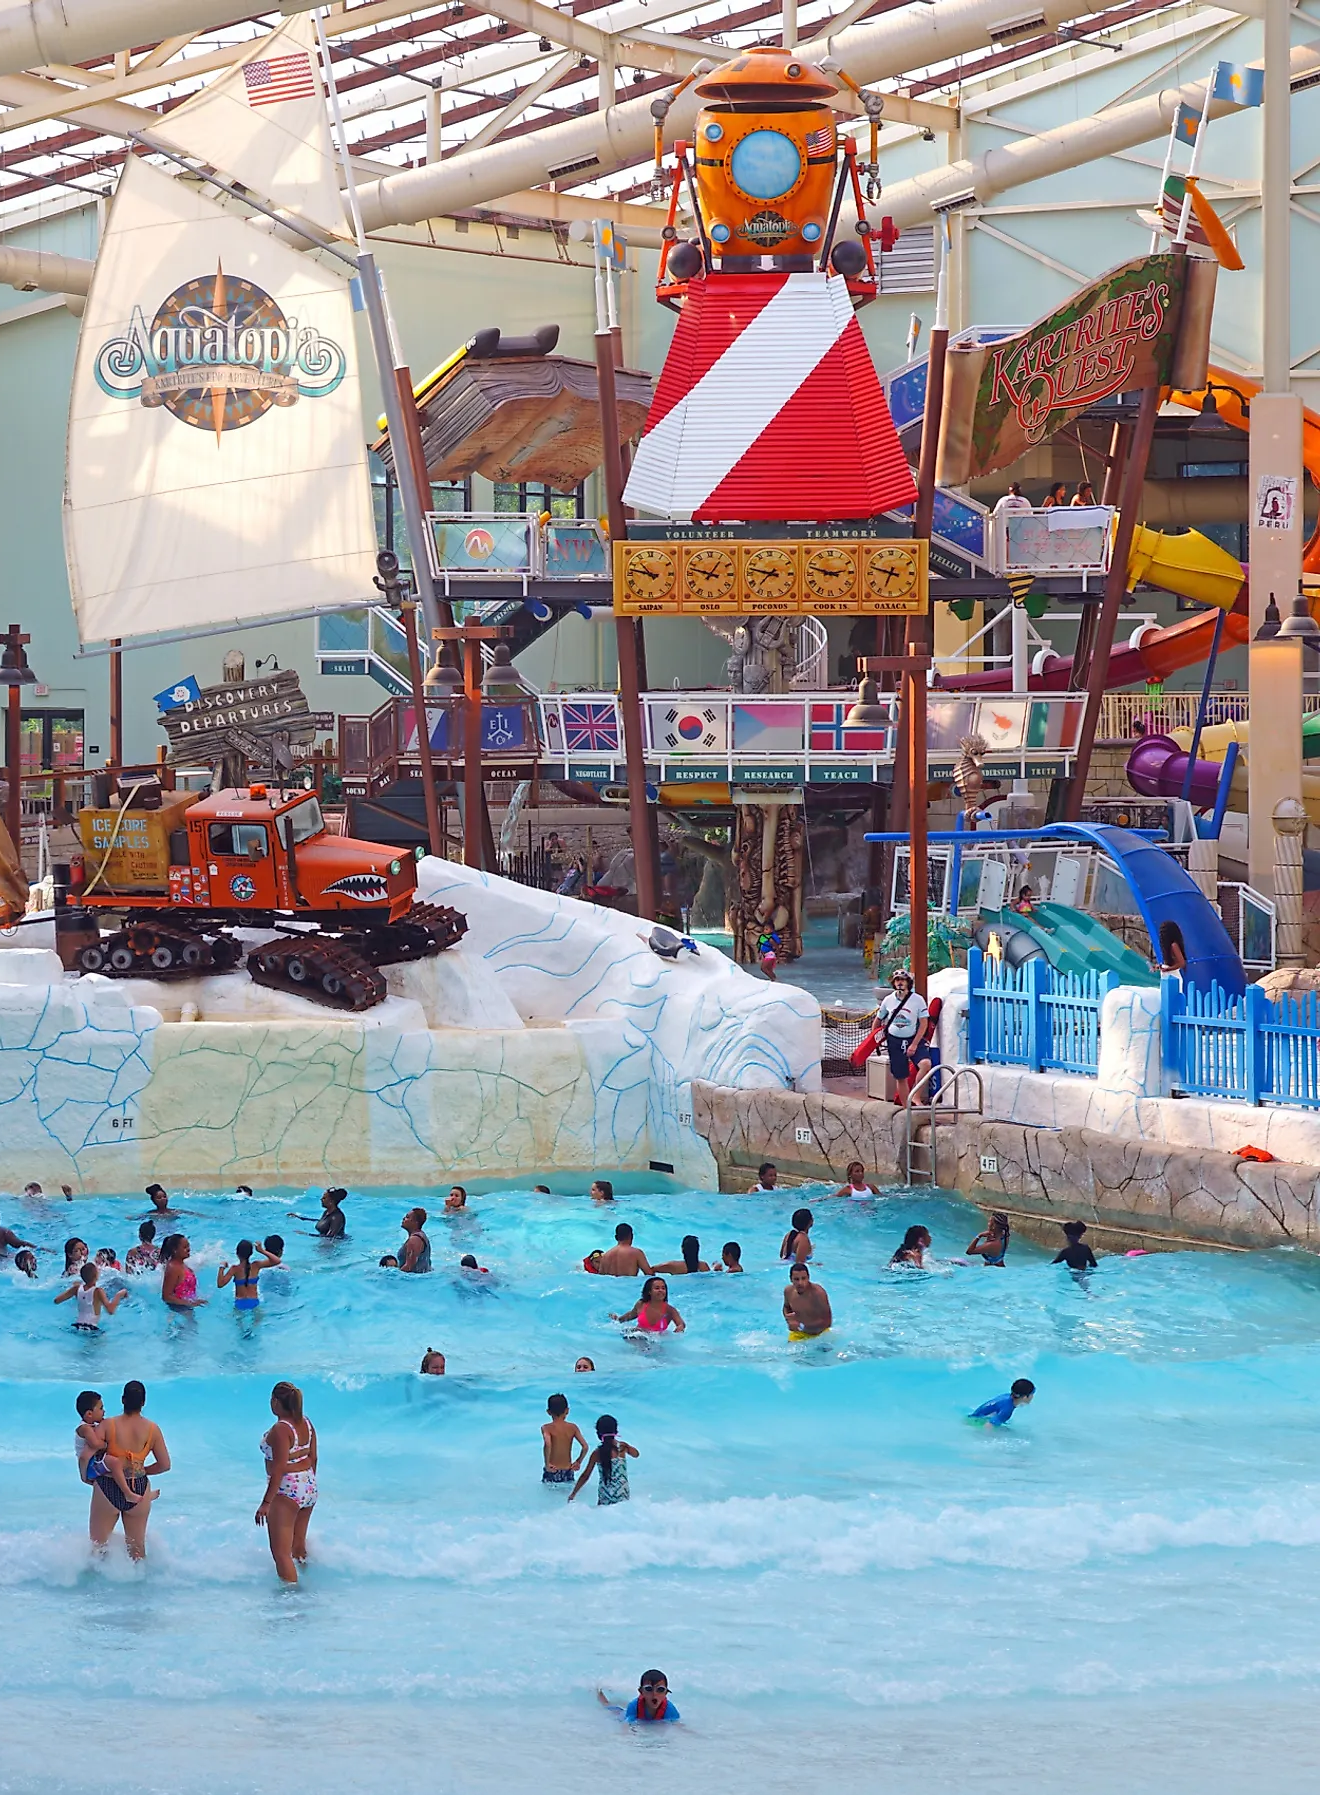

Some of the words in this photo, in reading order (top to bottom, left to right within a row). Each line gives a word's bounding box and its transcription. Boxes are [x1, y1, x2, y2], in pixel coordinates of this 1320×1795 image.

[737, 217, 797, 237] Aquatopia
[988, 279, 1170, 406] KARTRITE'S
[100, 305, 340, 392] Aquatopia
[1015, 334, 1136, 445] QUEST
[1258, 519, 1289, 528] PERU
[665, 531, 735, 539] VOLUNTEER
[806, 529, 878, 538] TEAMWORK
[552, 538, 594, 562] NW
[929, 552, 965, 576] ATELLITE
[184, 683, 280, 713] DISCOVERY
[180, 699, 293, 733] DEPARTURES
[490, 720, 496, 730] E
[491, 770, 517, 778] OCEAN
[575, 770, 608, 778] NEGOTIATE
[676, 771, 719, 779] RESPECT
[744, 772, 794, 780] RESEARCH
[824, 771, 859, 779] TEACH
[933, 770, 953, 778] EXPLO
[982, 769, 1017, 777] NDERSTAND
[379, 776, 391, 788] BAY
[346, 788, 366, 796] SOUND
[92, 818, 112, 832] ICE
[190, 820, 202, 833] 15
[112, 1118, 118, 1128] 6
[122, 1118, 134, 1128] FT
[798, 1130, 802, 1140] 5
[804, 1130, 810, 1140] FT
[982, 1158, 986, 1168] 4
[988, 1160, 996, 1170] FT
